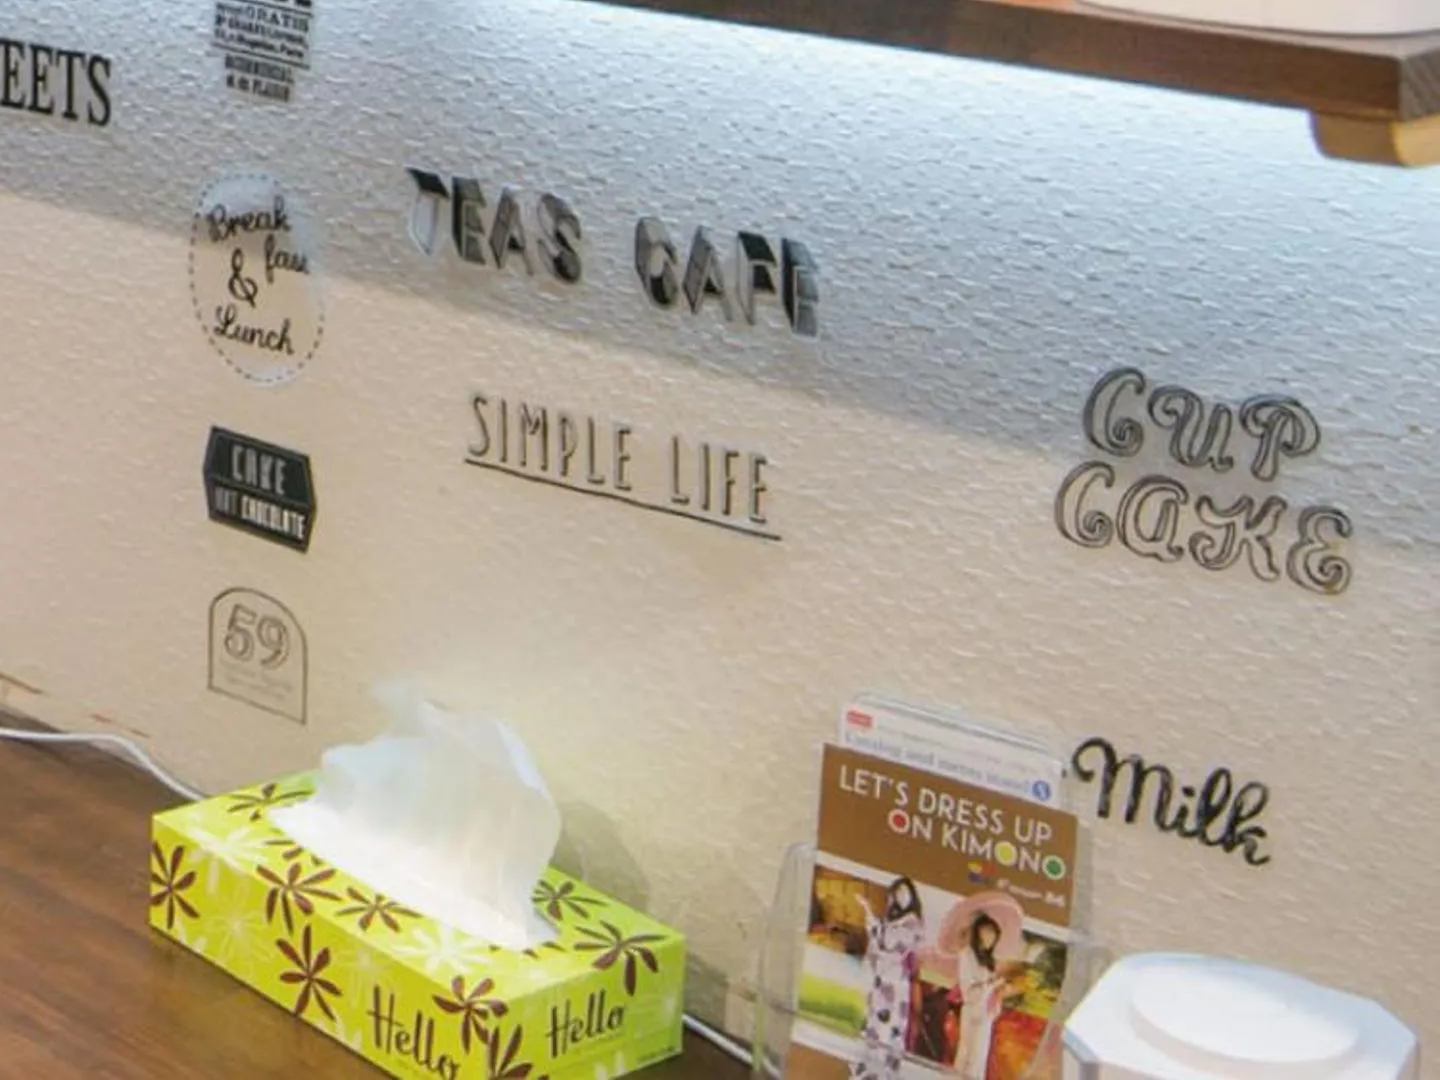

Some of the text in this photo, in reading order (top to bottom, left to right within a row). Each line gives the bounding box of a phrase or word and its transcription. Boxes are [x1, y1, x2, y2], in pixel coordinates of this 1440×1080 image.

[228, 248, 258, 308] &
[405, 166, 820, 337] TEAS CAFE
[213, 303, 295, 356] Lunch
[468, 393, 769, 524] SIMPLE LIFE
[1082, 367, 1322, 483] CUP
[1055, 460, 1354, 596] CAKE
[839, 765, 1053, 848] LET'S DRESS UP
[887, 808, 1067, 881] ON KIMONO
[1071, 736, 1271, 867] Milk
[366, 984, 460, 1080] Hello
[545, 987, 627, 1059] Hello
